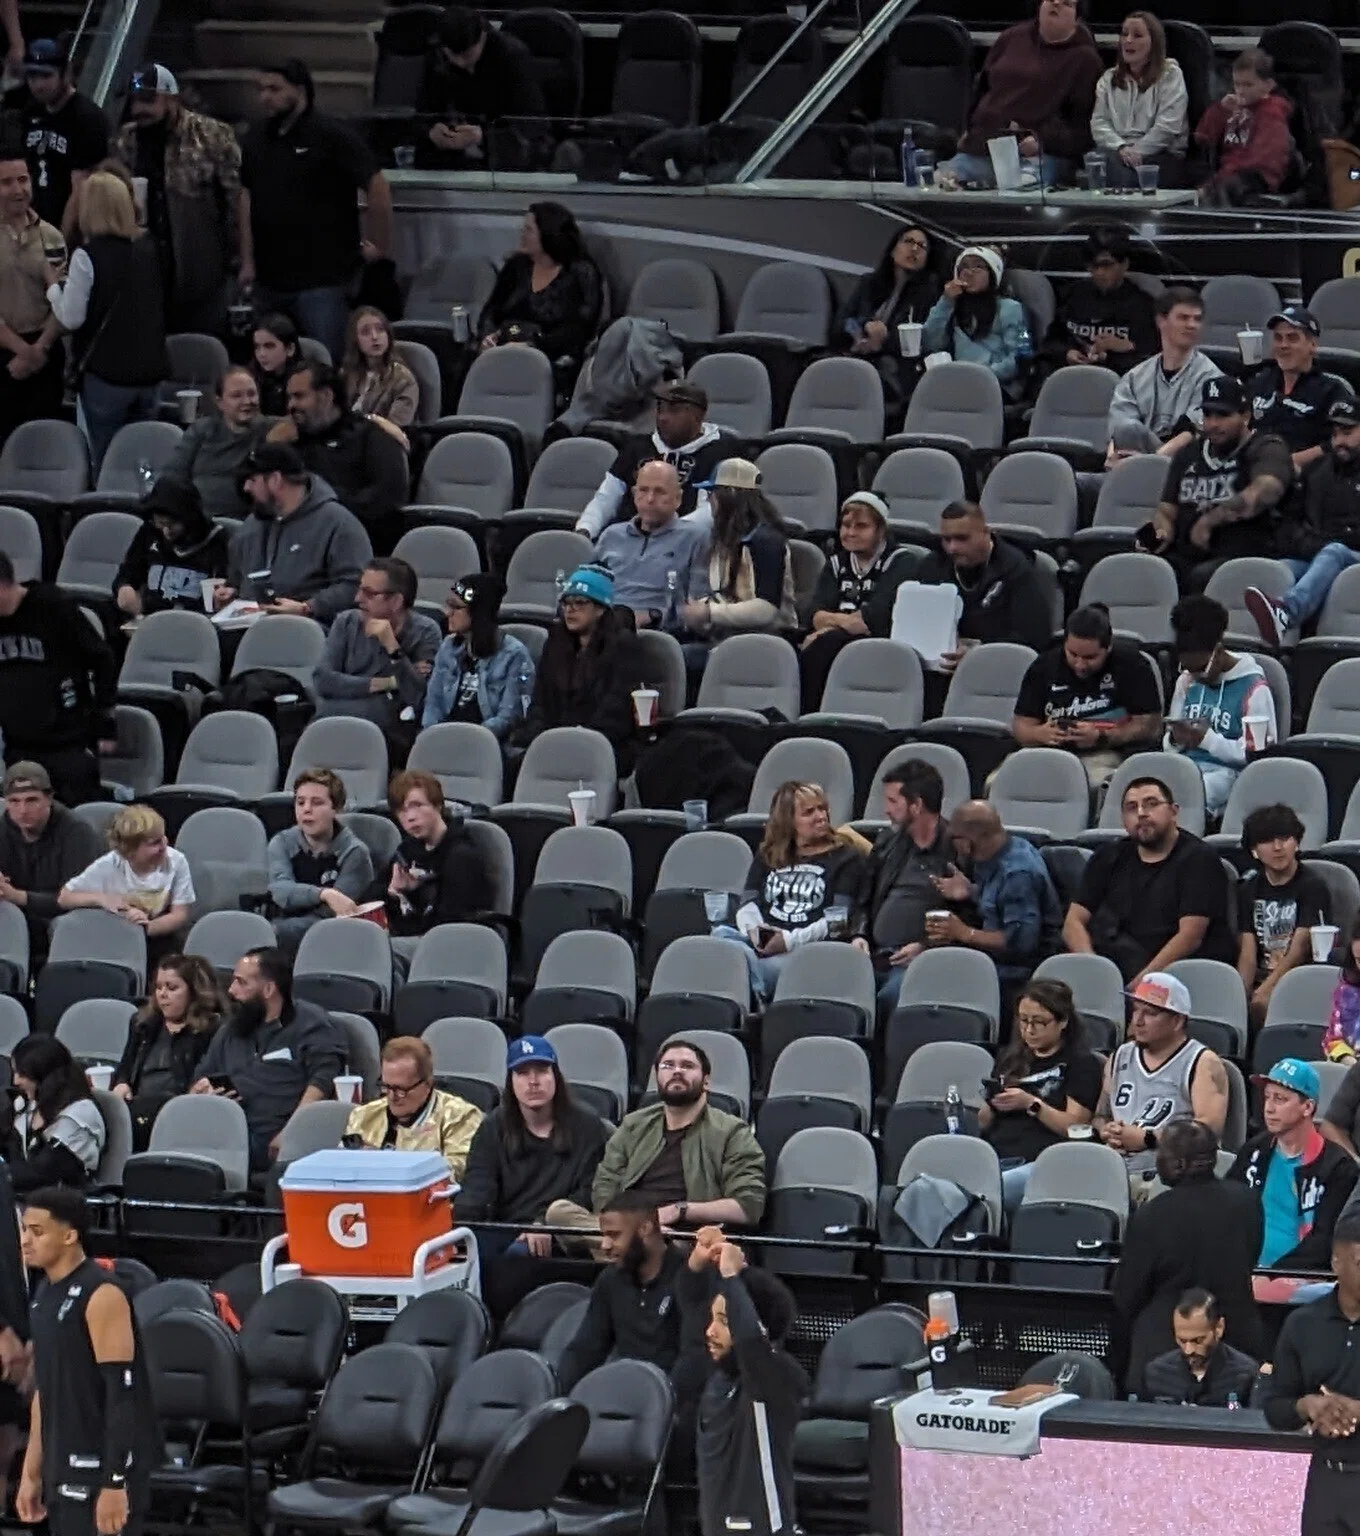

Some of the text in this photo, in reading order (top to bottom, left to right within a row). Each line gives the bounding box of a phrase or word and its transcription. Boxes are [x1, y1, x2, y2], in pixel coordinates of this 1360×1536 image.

[1115, 1083, 1132, 1108] 6
[327, 1202, 369, 1249] G
[930, 1345, 947, 1364] G
[916, 1412, 1011, 1436] GATORADE
